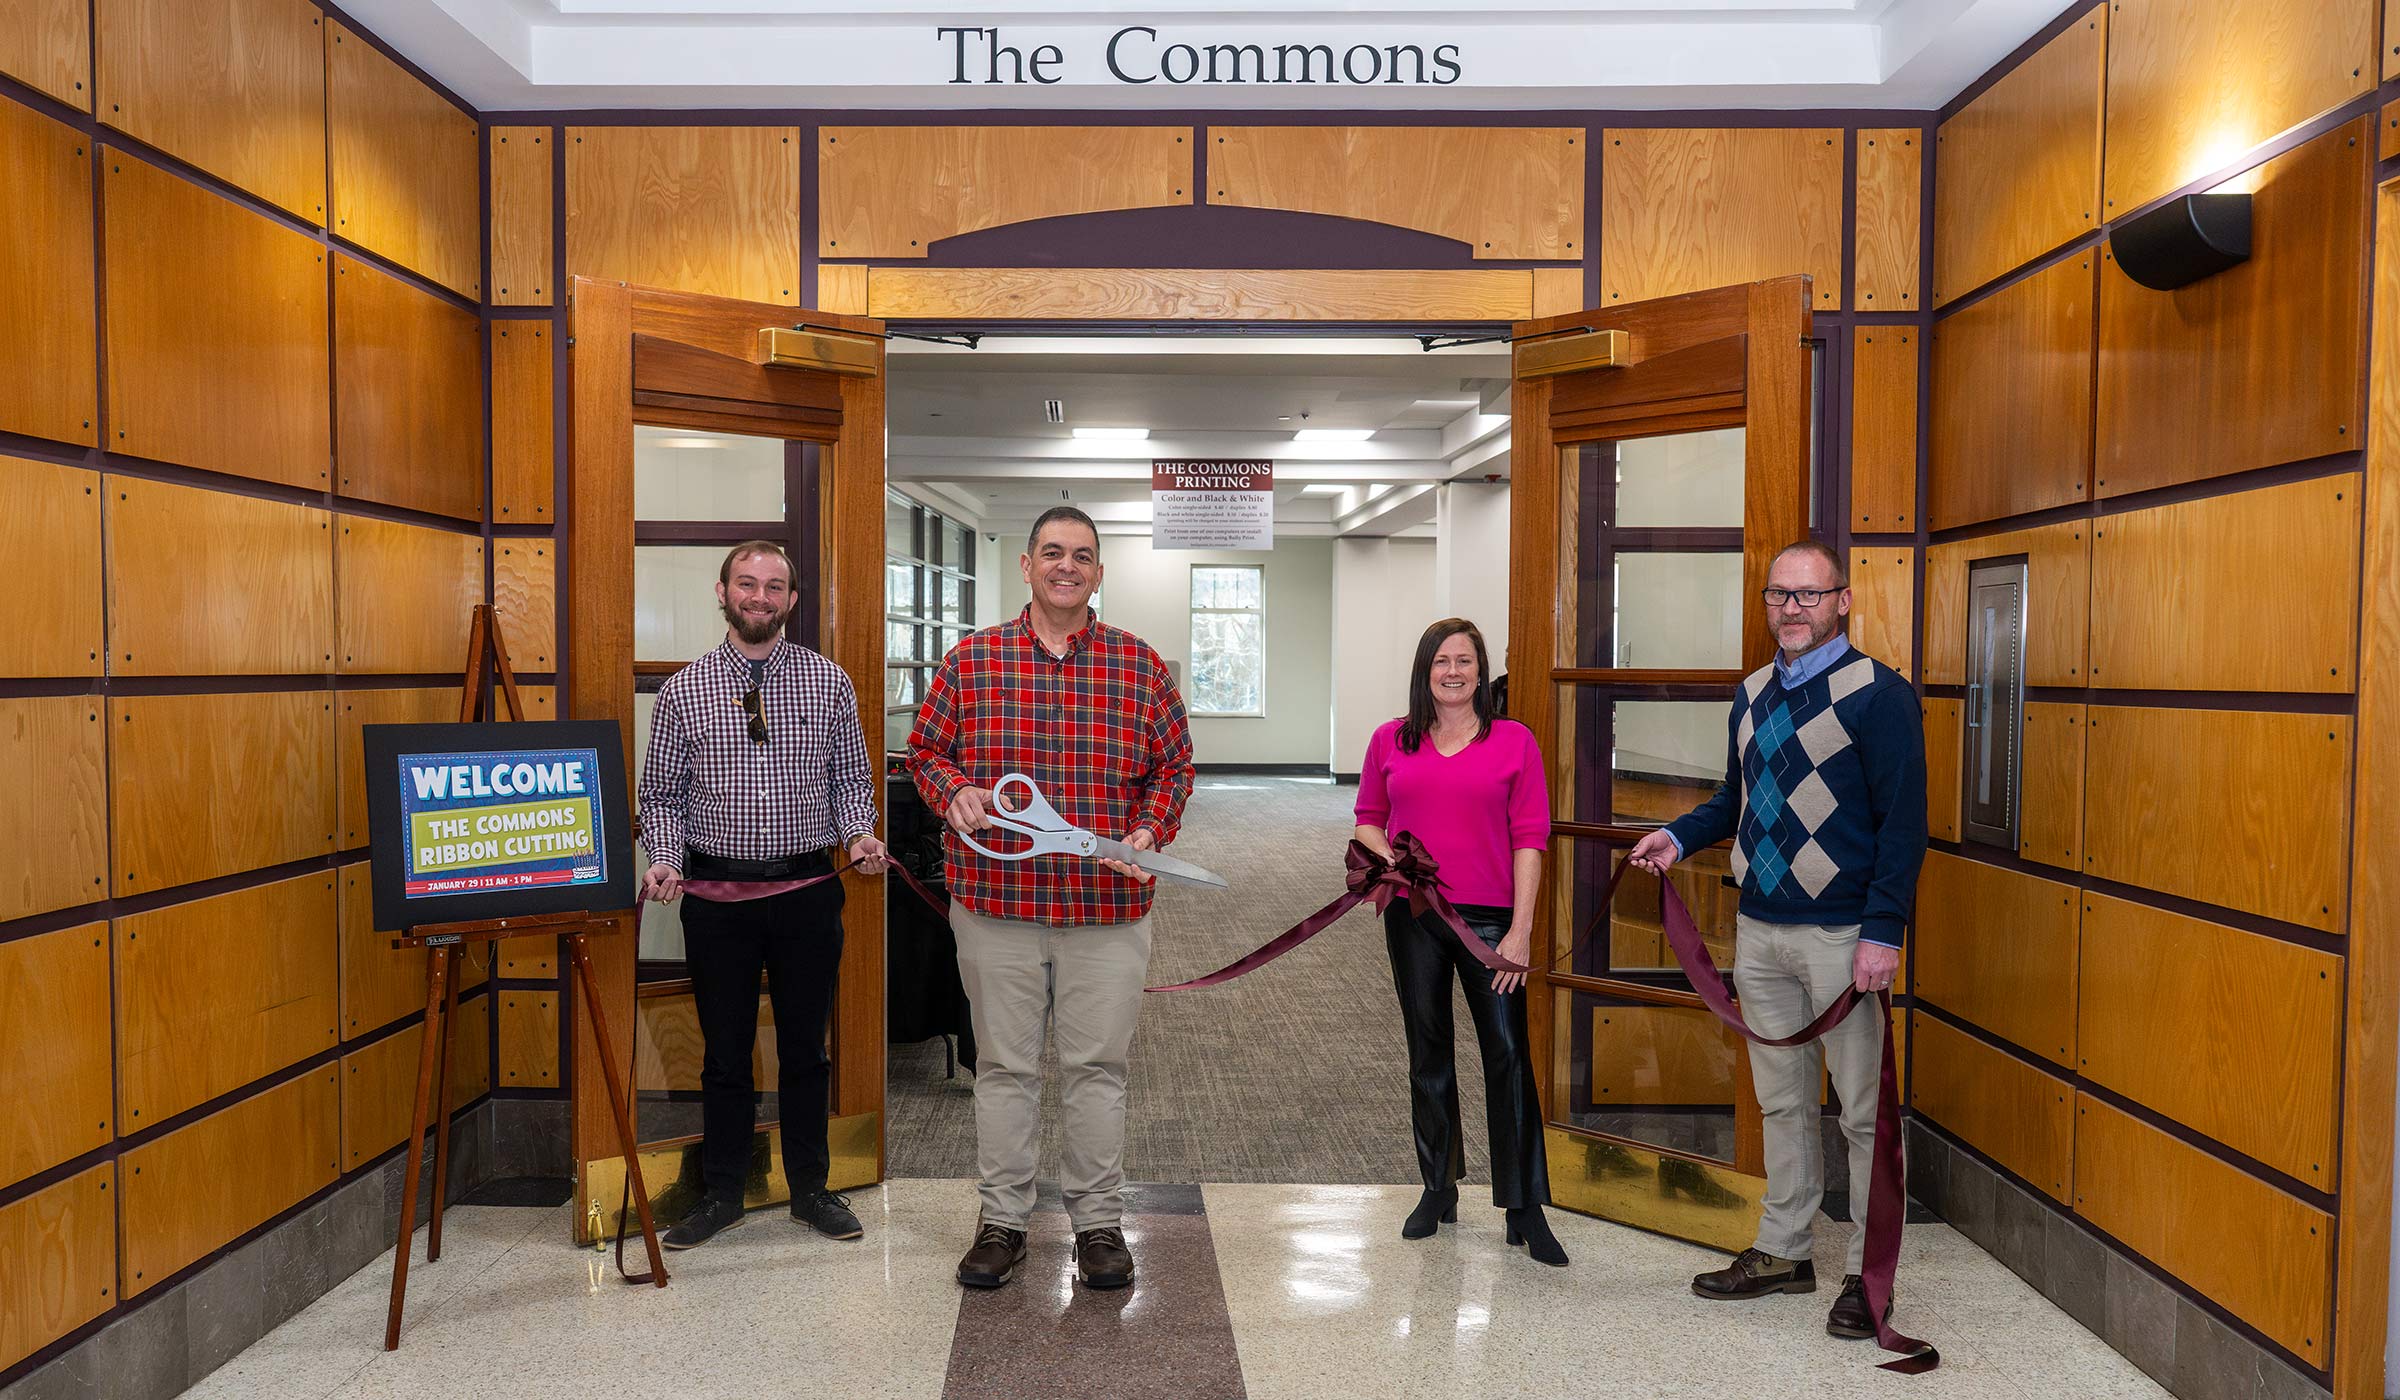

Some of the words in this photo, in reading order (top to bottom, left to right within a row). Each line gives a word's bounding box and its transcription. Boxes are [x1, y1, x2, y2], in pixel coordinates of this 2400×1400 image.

[937, 26, 1064, 84] The
[1106, 26, 1463, 84] Commons
[1155, 462, 1186, 475] THE
[1188, 462, 1271, 475] COMMONS
[1175, 476, 1251, 488] PRINTING
[1161, 494, 1184, 502] Color
[1186, 494, 1202, 502] and
[1204, 494, 1227, 502] Black
[1229, 494, 1237, 502] &
[1239, 494, 1265, 502] White
[411, 762, 585, 799] WELCOME
[428, 818, 471, 840] THE
[476, 807, 576, 835] COMMONS
[420, 840, 499, 867] RIBBON
[504, 829, 589, 856] CUTTING
[428, 880, 466, 891] JANUARY
[468, 879, 478, 887] 29
[485, 878, 493, 887] 11
[495, 877, 508, 886] AM
[521, 876, 532, 884] PM
